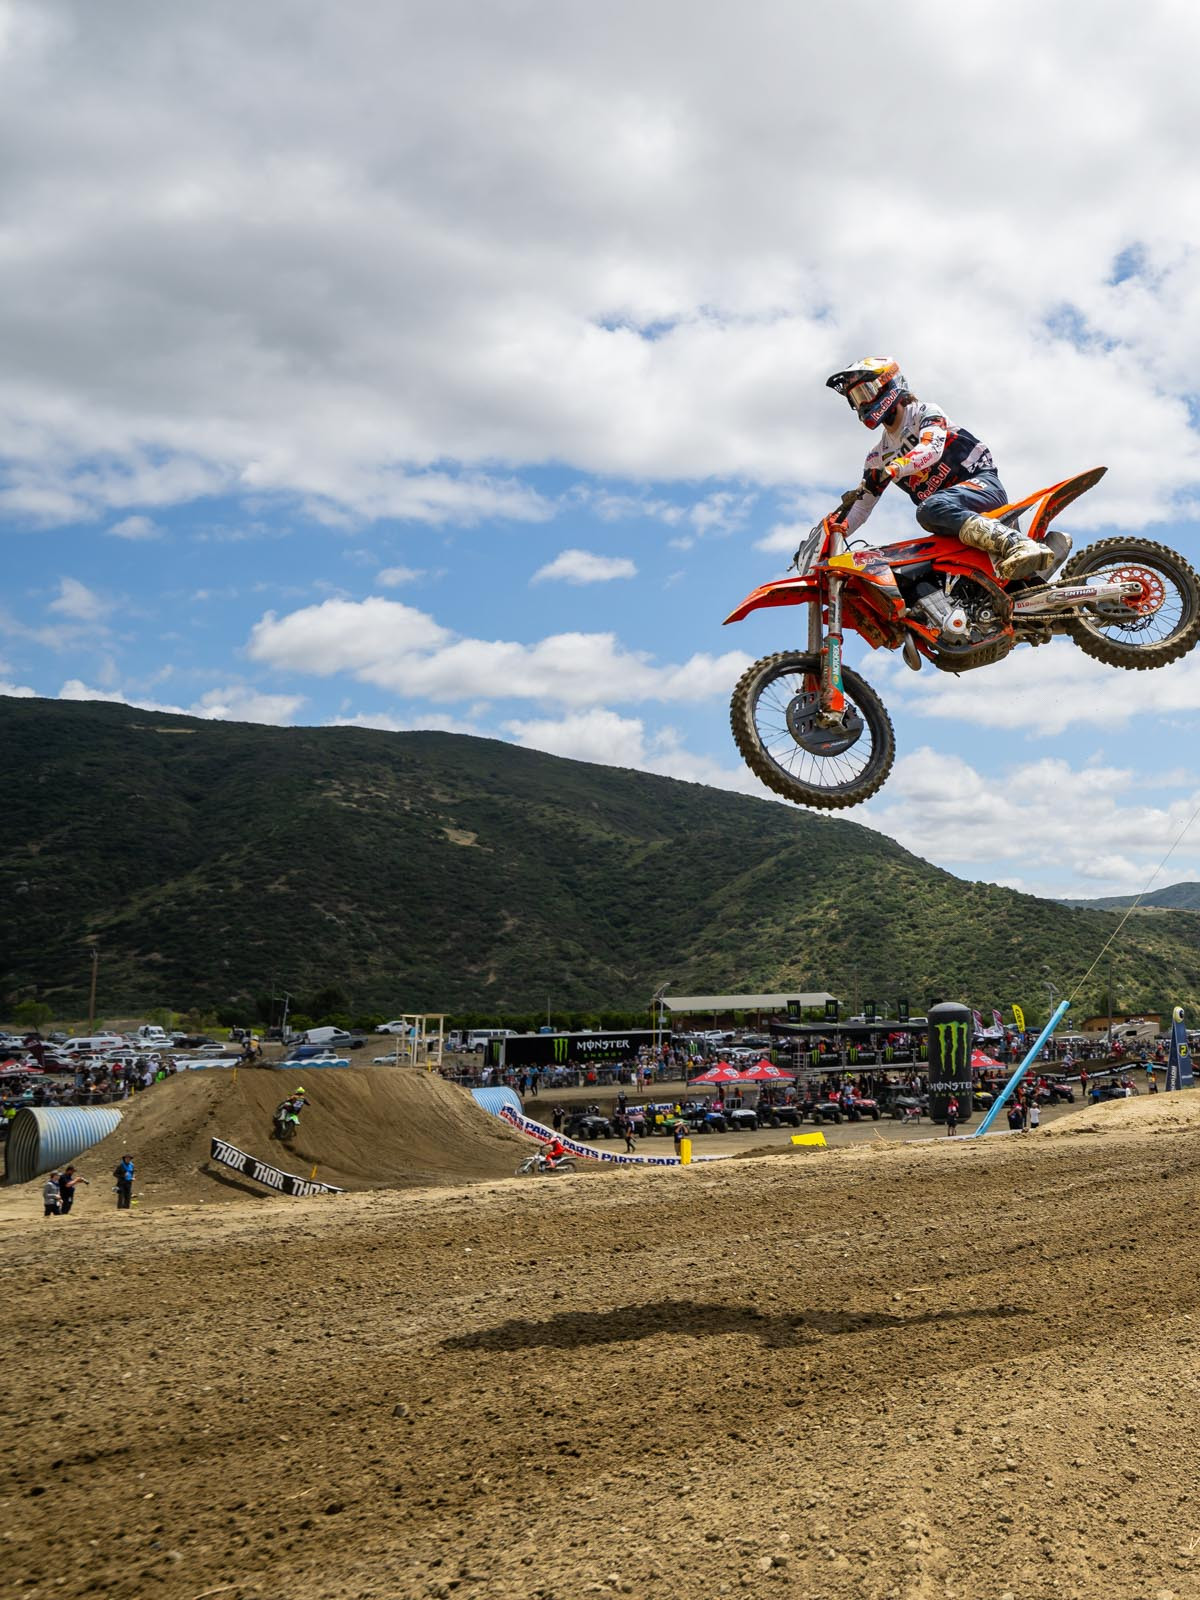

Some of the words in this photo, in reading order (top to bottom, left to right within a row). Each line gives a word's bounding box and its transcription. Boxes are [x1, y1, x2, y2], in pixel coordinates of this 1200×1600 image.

[576, 1040, 631, 1052] MONSTER
[562, 1139, 599, 1159] PARTS
[212, 1142, 247, 1172] THOR
[252, 1162, 284, 1190] THOR
